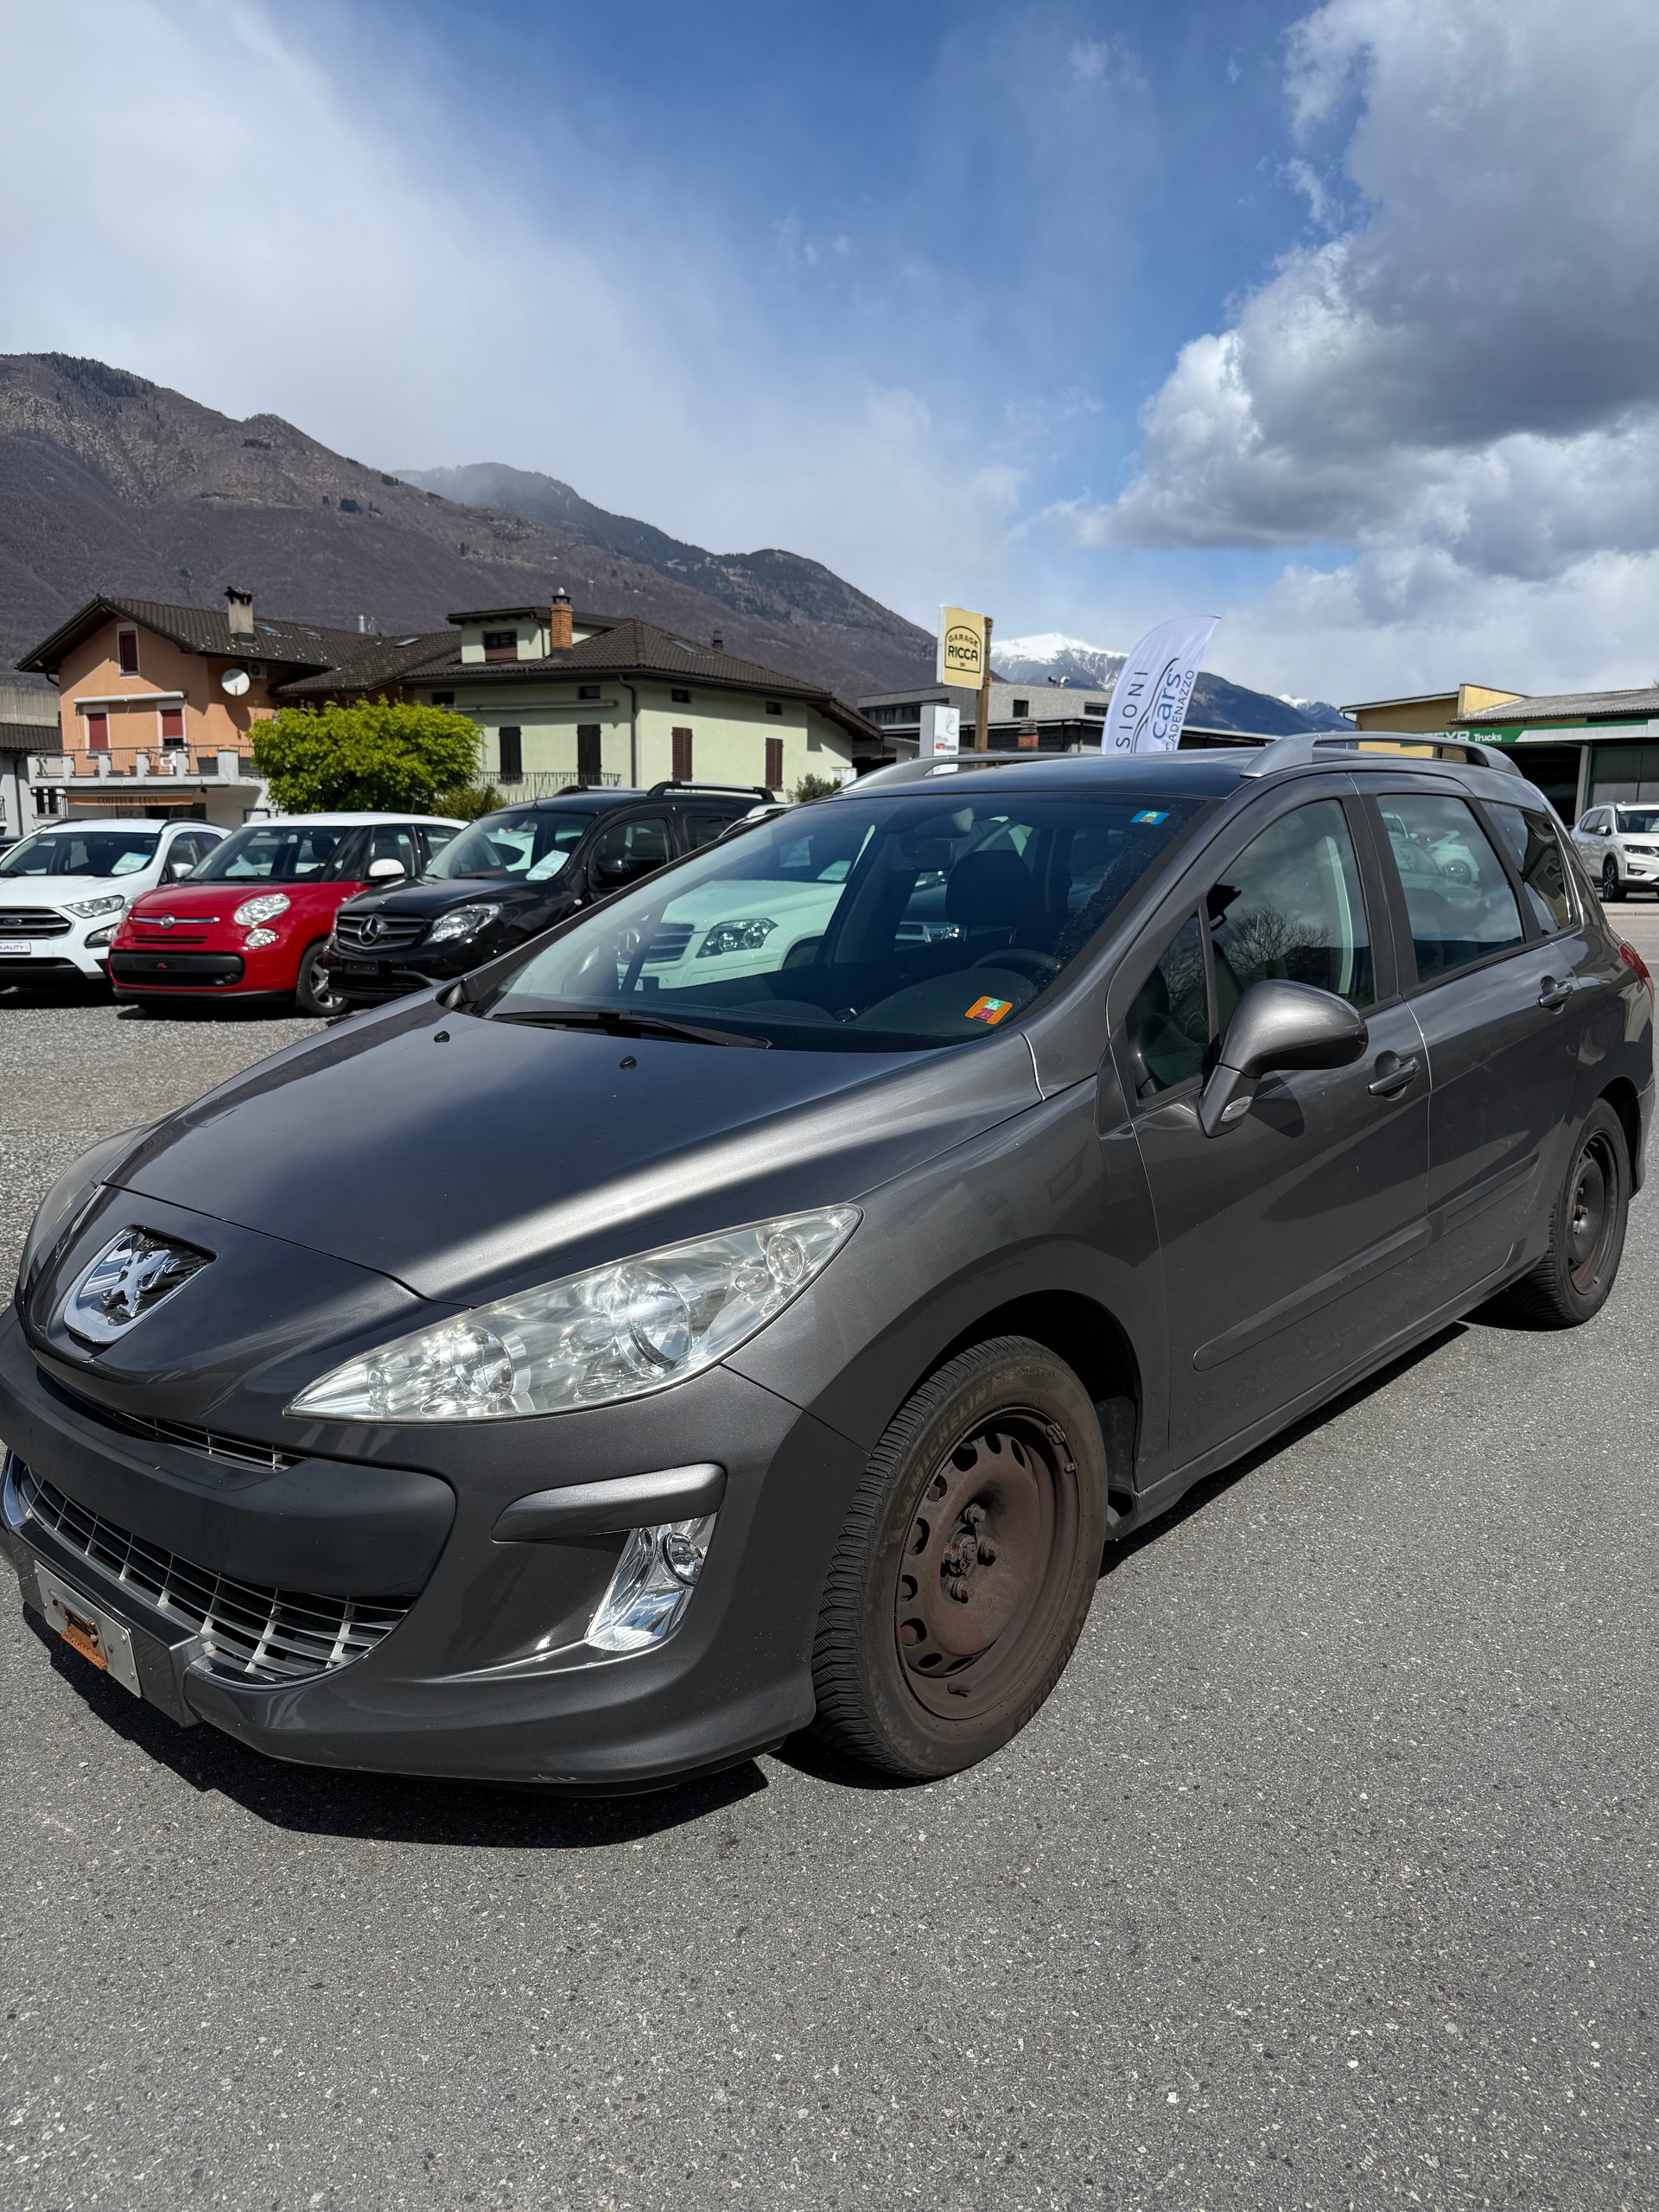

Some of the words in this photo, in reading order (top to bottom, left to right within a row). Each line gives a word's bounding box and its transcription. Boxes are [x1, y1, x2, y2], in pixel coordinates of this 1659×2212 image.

[949, 634, 978, 648] GARAGE
[948, 645, 978, 662] RICCA
[1473, 733, 1502, 742] Trucks
[910, 1386, 987, 1492] MICHELIN
